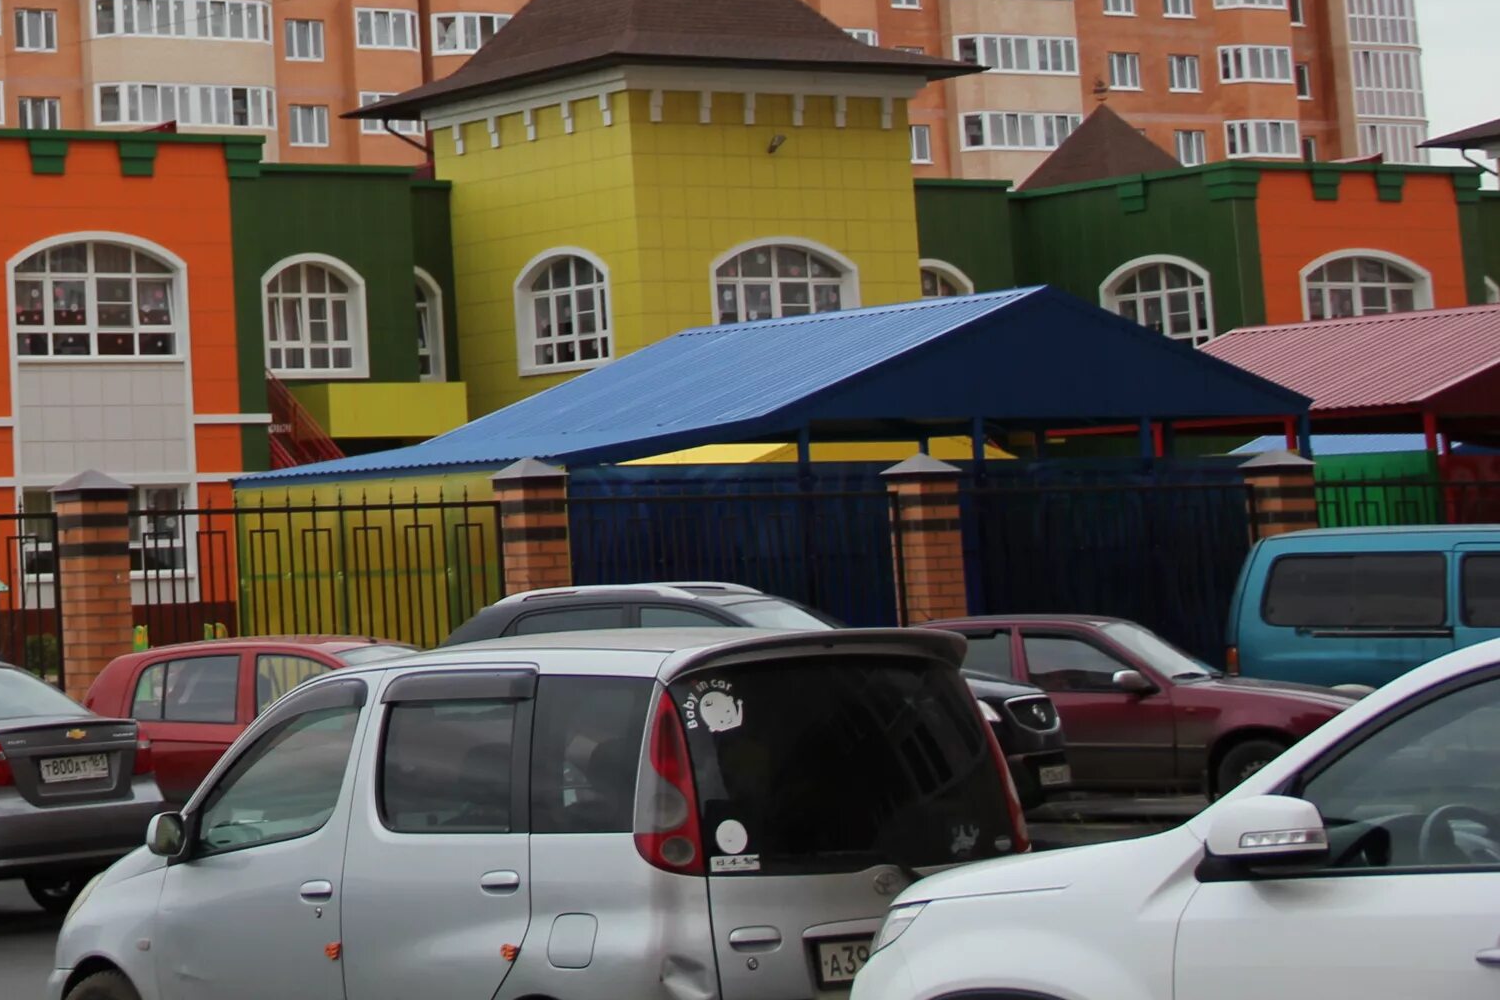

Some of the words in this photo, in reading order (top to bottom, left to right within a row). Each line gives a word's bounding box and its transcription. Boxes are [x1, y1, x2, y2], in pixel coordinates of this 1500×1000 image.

[682, 692, 699, 729] Baby
[692, 680, 709, 692] in
[710, 679, 733, 691] car
[44, 758, 88, 777] Т800АТ
